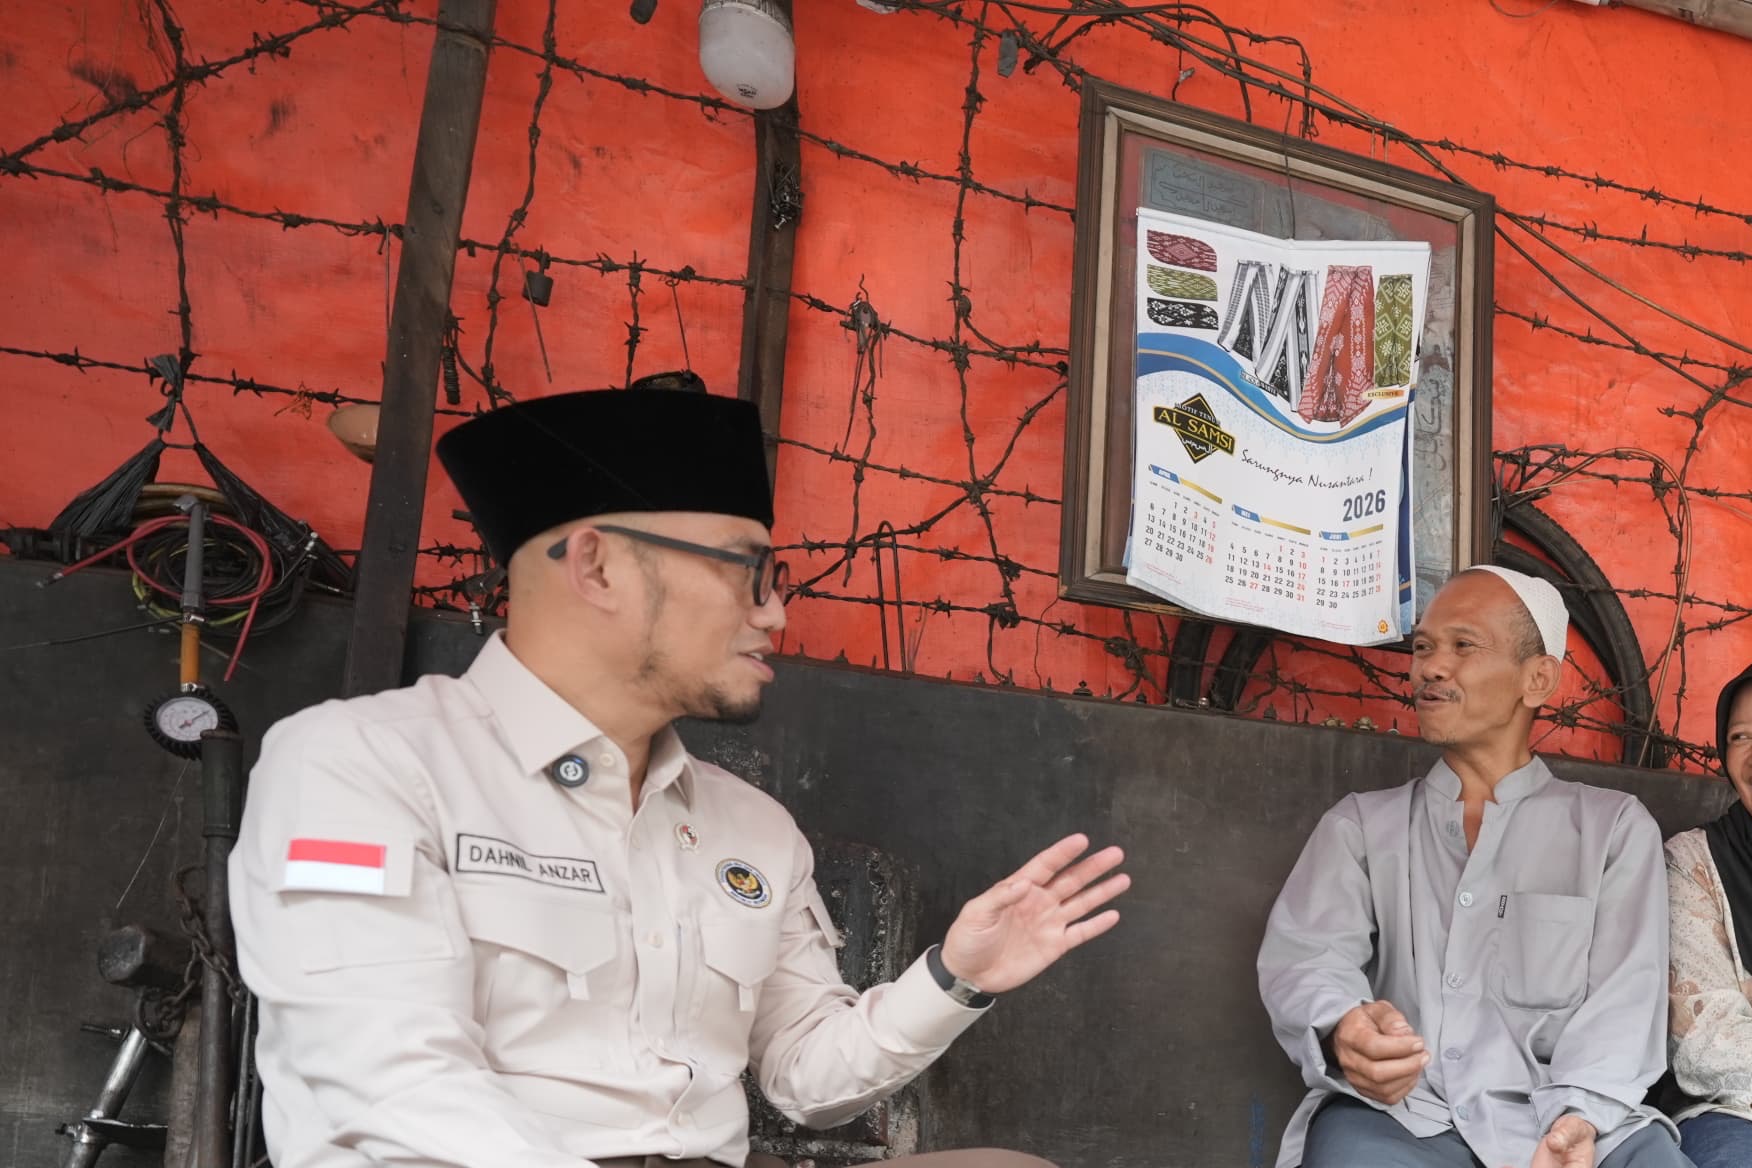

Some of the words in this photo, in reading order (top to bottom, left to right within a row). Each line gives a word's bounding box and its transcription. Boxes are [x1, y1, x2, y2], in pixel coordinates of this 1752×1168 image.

[1158, 409, 1182, 426] AL
[1187, 419, 1233, 450] SAMSI
[1240, 449, 1304, 486] Sarungnya
[1307, 474, 1365, 489] Nusantara
[1174, 501, 1177, 509] 1
[1184, 506, 1188, 514] 2
[1342, 489, 1386, 522] 2026
[1148, 514, 1155, 522] 13
[1159, 519, 1165, 528] 14
[1170, 524, 1176, 533] 15
[1180, 529, 1186, 538] 16
[1190, 534, 1196, 542] 17
[1192, 523, 1197, 531] 10
[1201, 528, 1206, 536] 11
[1145, 538, 1152, 546] 27
[1166, 548, 1173, 557] 29
[1146, 526, 1153, 534] 20
[1157, 531, 1164, 539] 21
[1167, 536, 1175, 545] 22
[1177, 541, 1184, 549] 23
[1187, 546, 1194, 554] 24
[1197, 551, 1204, 559] 25
[1228, 553, 1235, 561] 11
[1240, 557, 1248, 565] 12
[1252, 560, 1259, 568] 13
[1288, 569, 1294, 577] 16
[1240, 568, 1247, 576] 19
[1286, 580, 1294, 588] 23
[470, 845, 533, 872] DAHNIL
[538, 863, 592, 883] ANZAR
